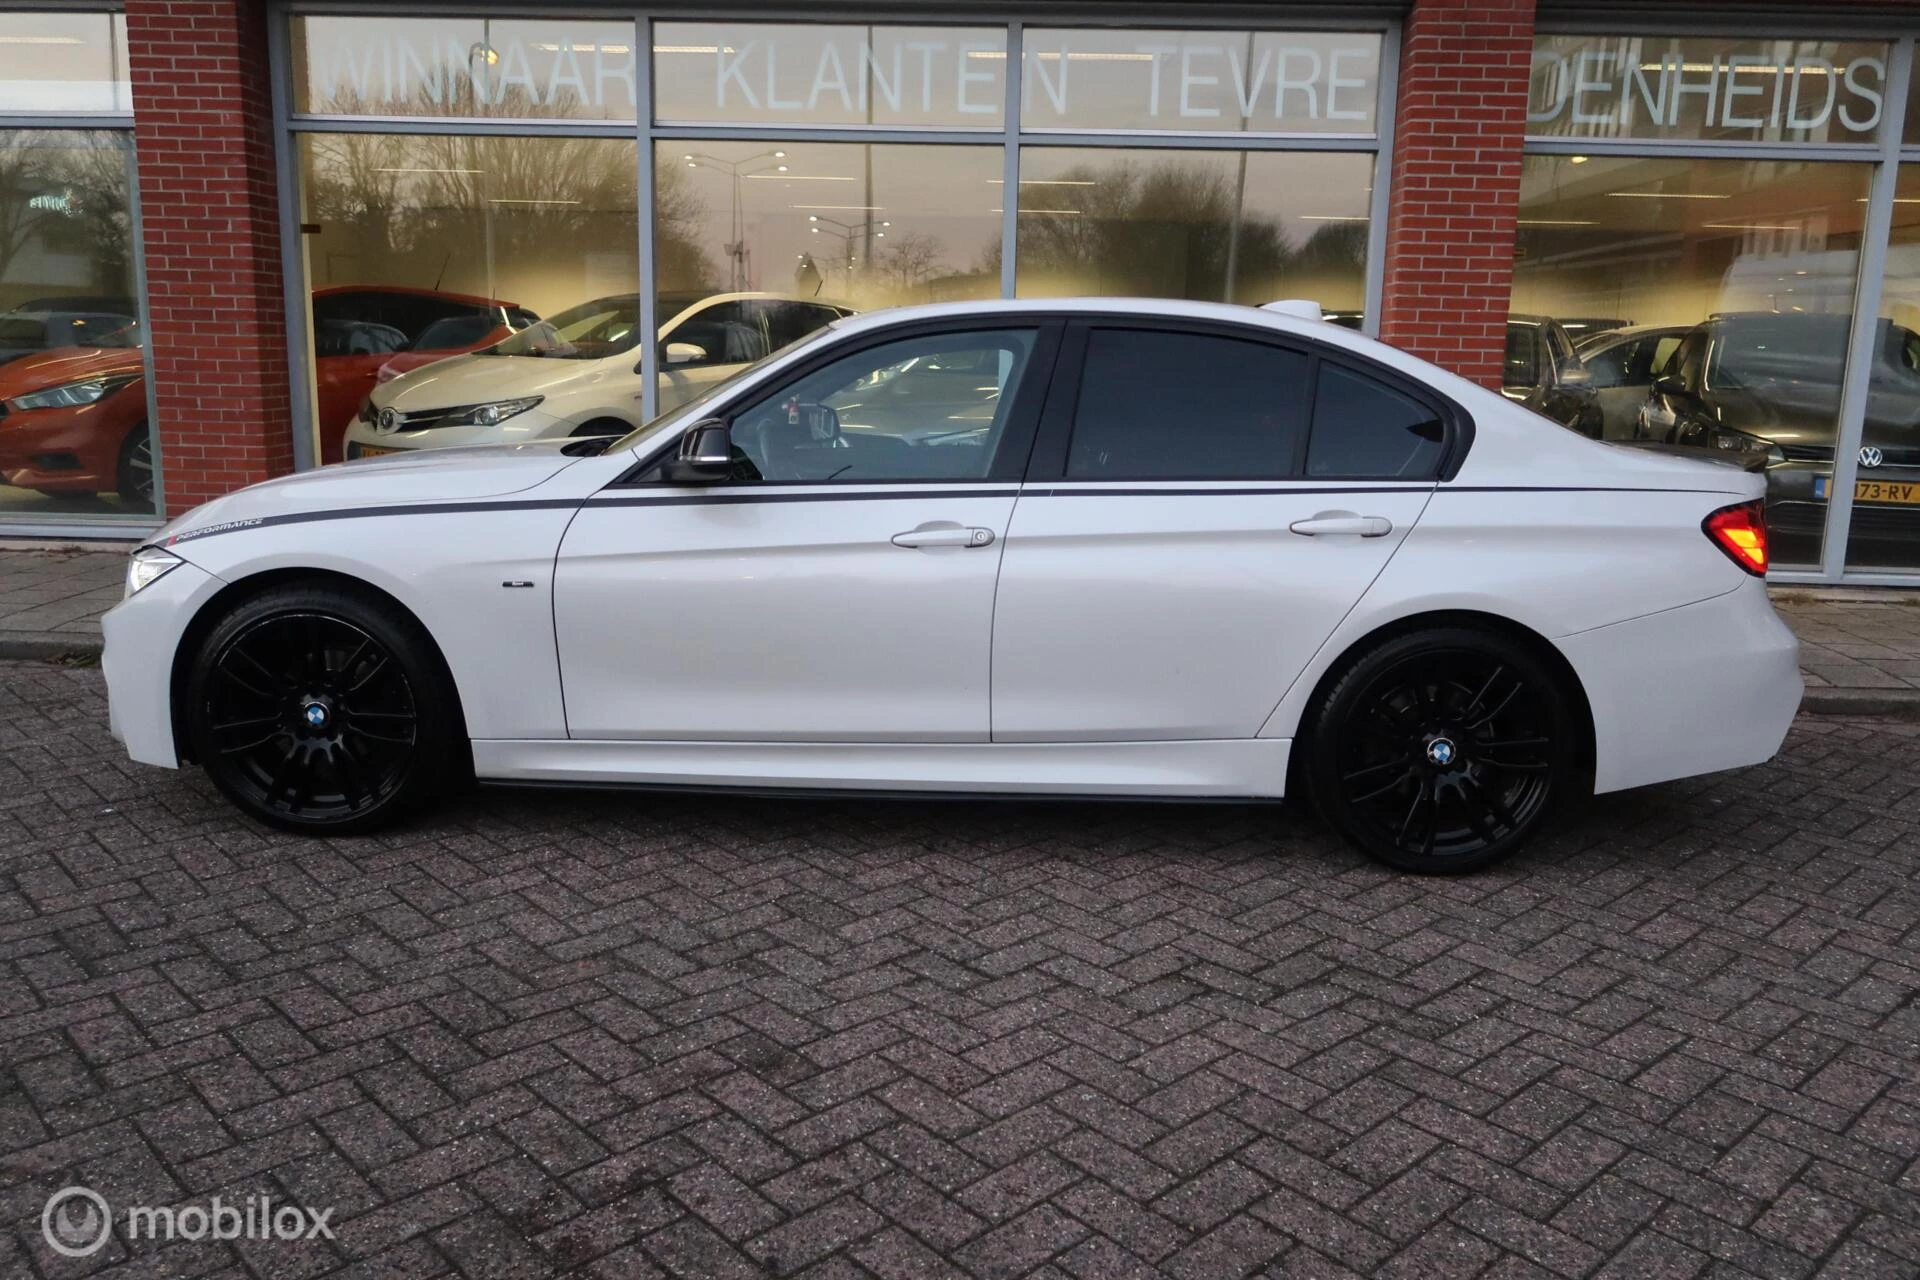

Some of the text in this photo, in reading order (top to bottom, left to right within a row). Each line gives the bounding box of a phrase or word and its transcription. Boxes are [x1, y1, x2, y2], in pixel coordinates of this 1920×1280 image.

[317, 34, 1885, 132] WINNAAR KLANTEN TEVRE DENHEIDS
